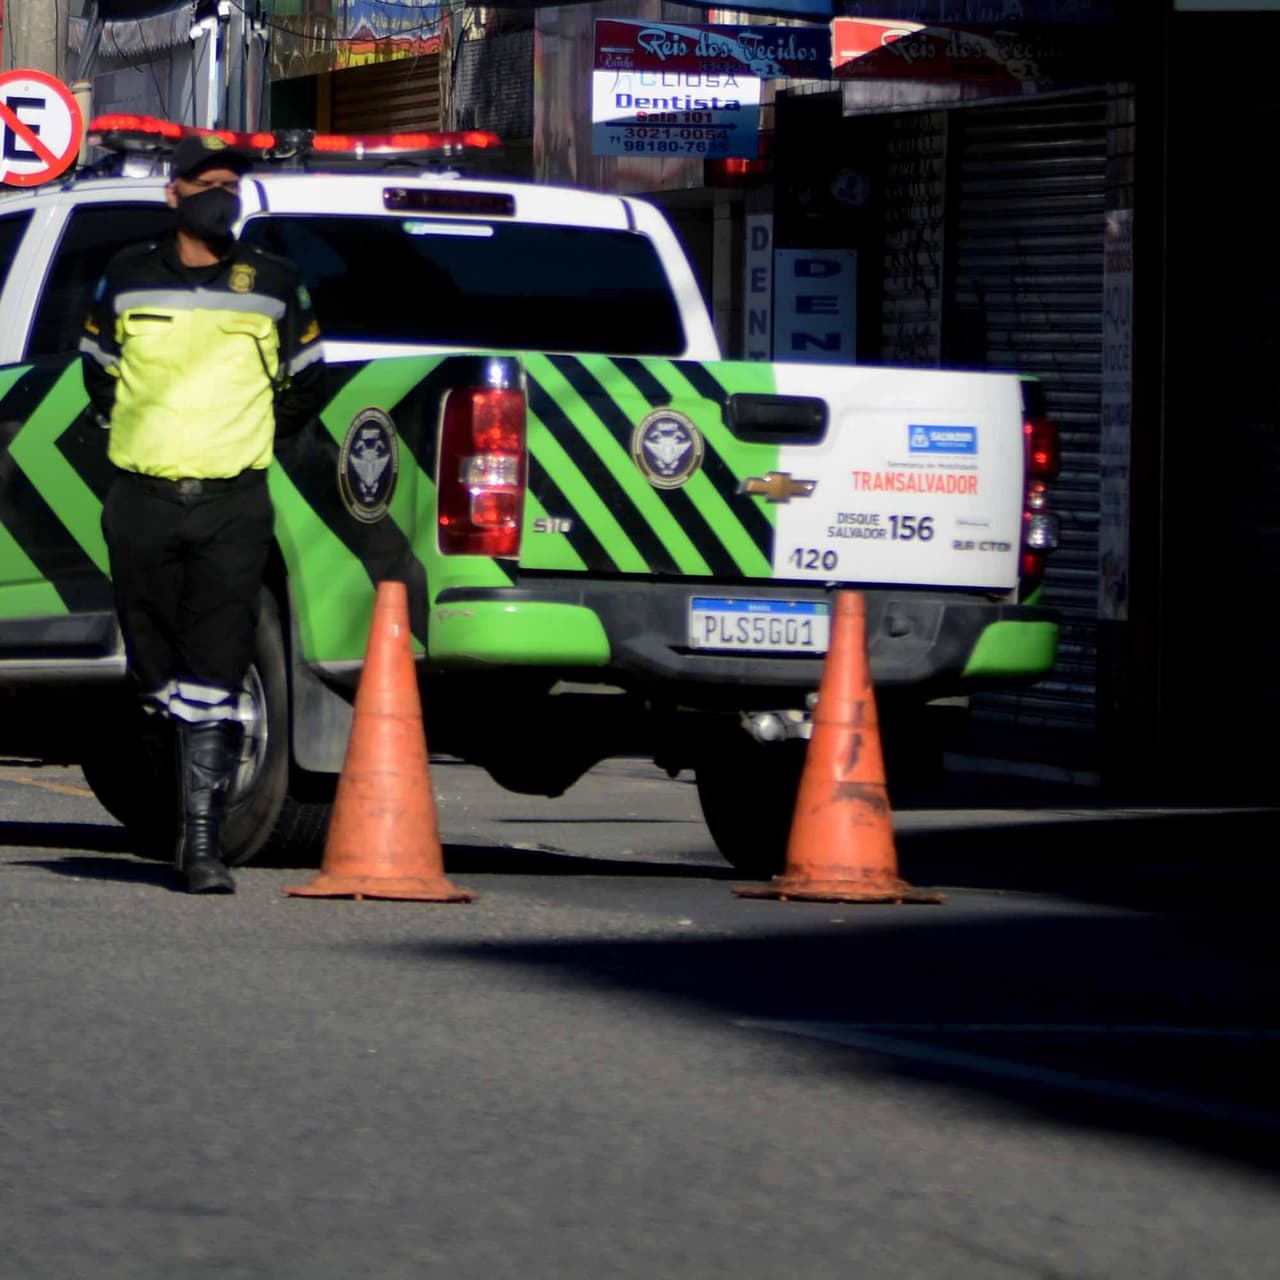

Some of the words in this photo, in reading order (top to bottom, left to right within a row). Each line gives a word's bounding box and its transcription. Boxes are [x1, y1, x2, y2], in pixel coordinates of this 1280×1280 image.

[638, 27, 689, 62] Reis
[695, 31, 733, 58] dos
[737, 28, 818, 61] Tecidos
[615, 93, 740, 111] Dentista
[682, 112, 713, 124] 101
[852, 471, 978, 495] TRANSALVADOR
[837, 511, 880, 525] DISQUE
[888, 515, 935, 541] 156
[827, 526, 888, 540] SALVADOR
[792, 548, 839, 571] 120
[704, 615, 814, 646] PLS5G01
